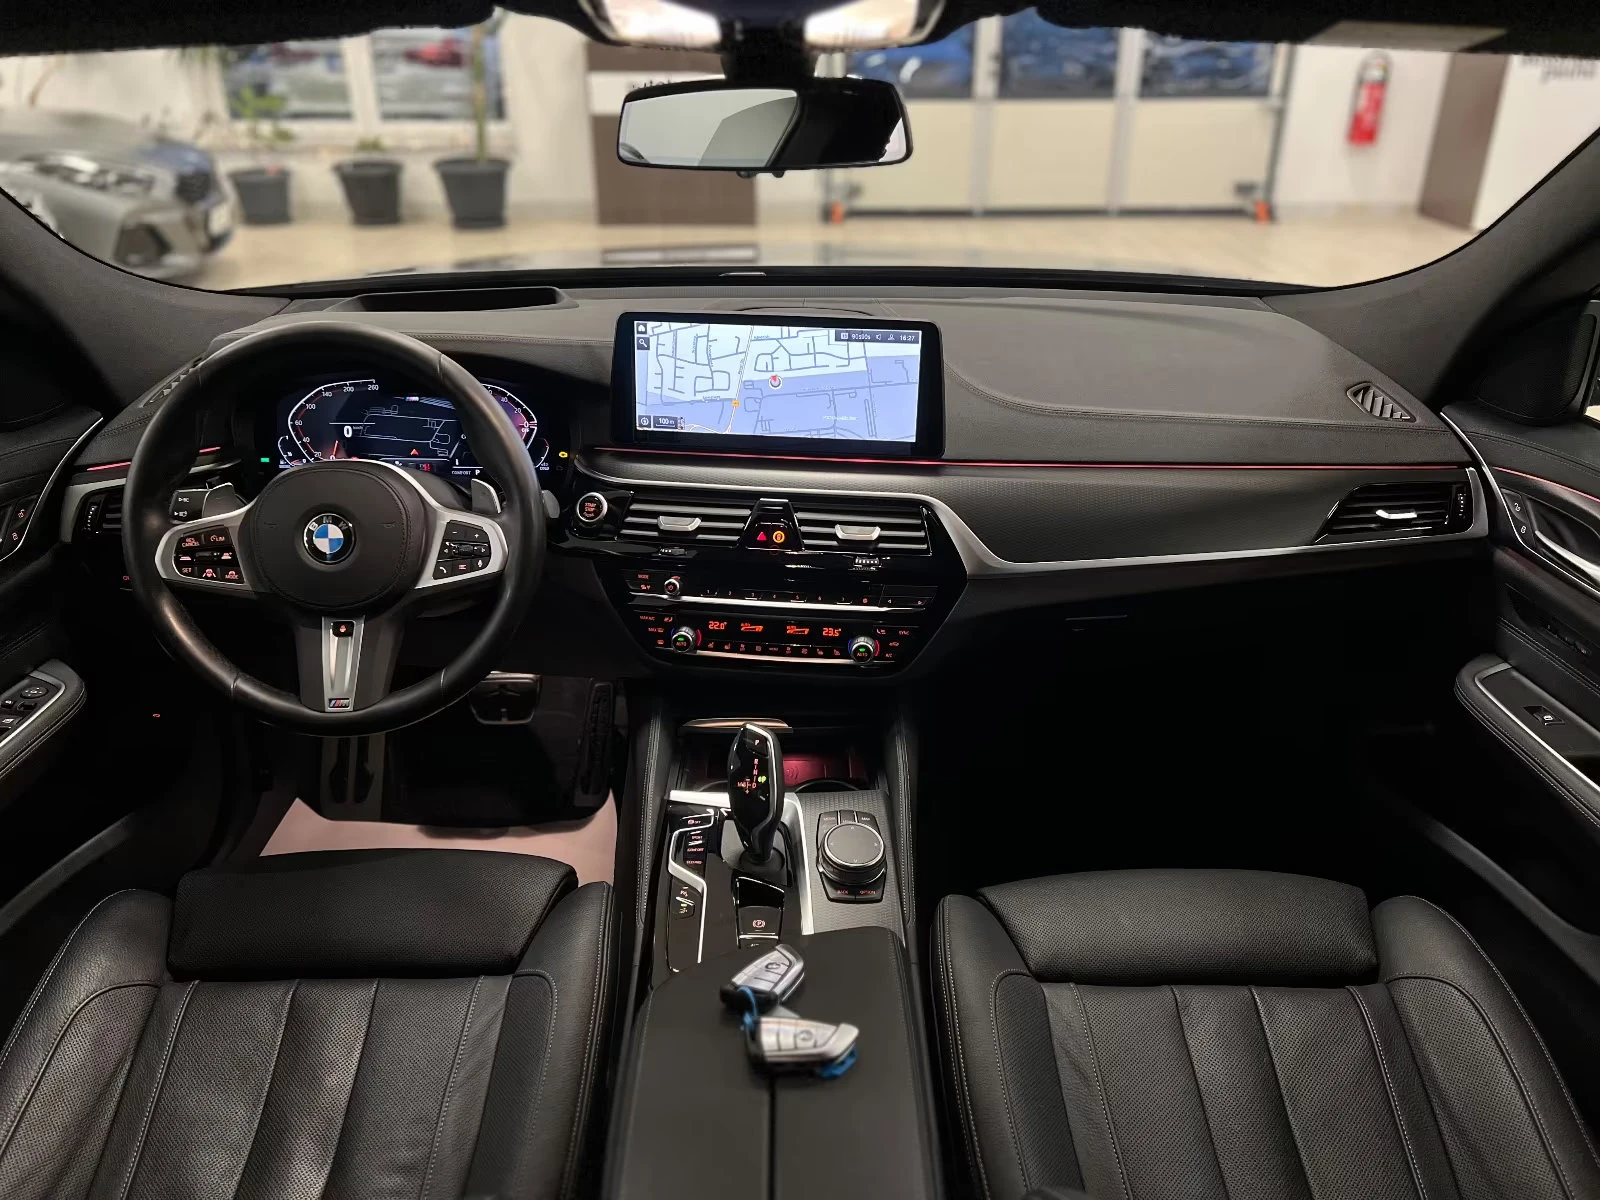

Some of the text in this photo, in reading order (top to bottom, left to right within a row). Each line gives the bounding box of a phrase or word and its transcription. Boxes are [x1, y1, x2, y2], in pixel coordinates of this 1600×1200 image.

[899, 334, 915, 342] 16:27
[658, 417, 669, 425] 100
[343, 425, 353, 438] 0
